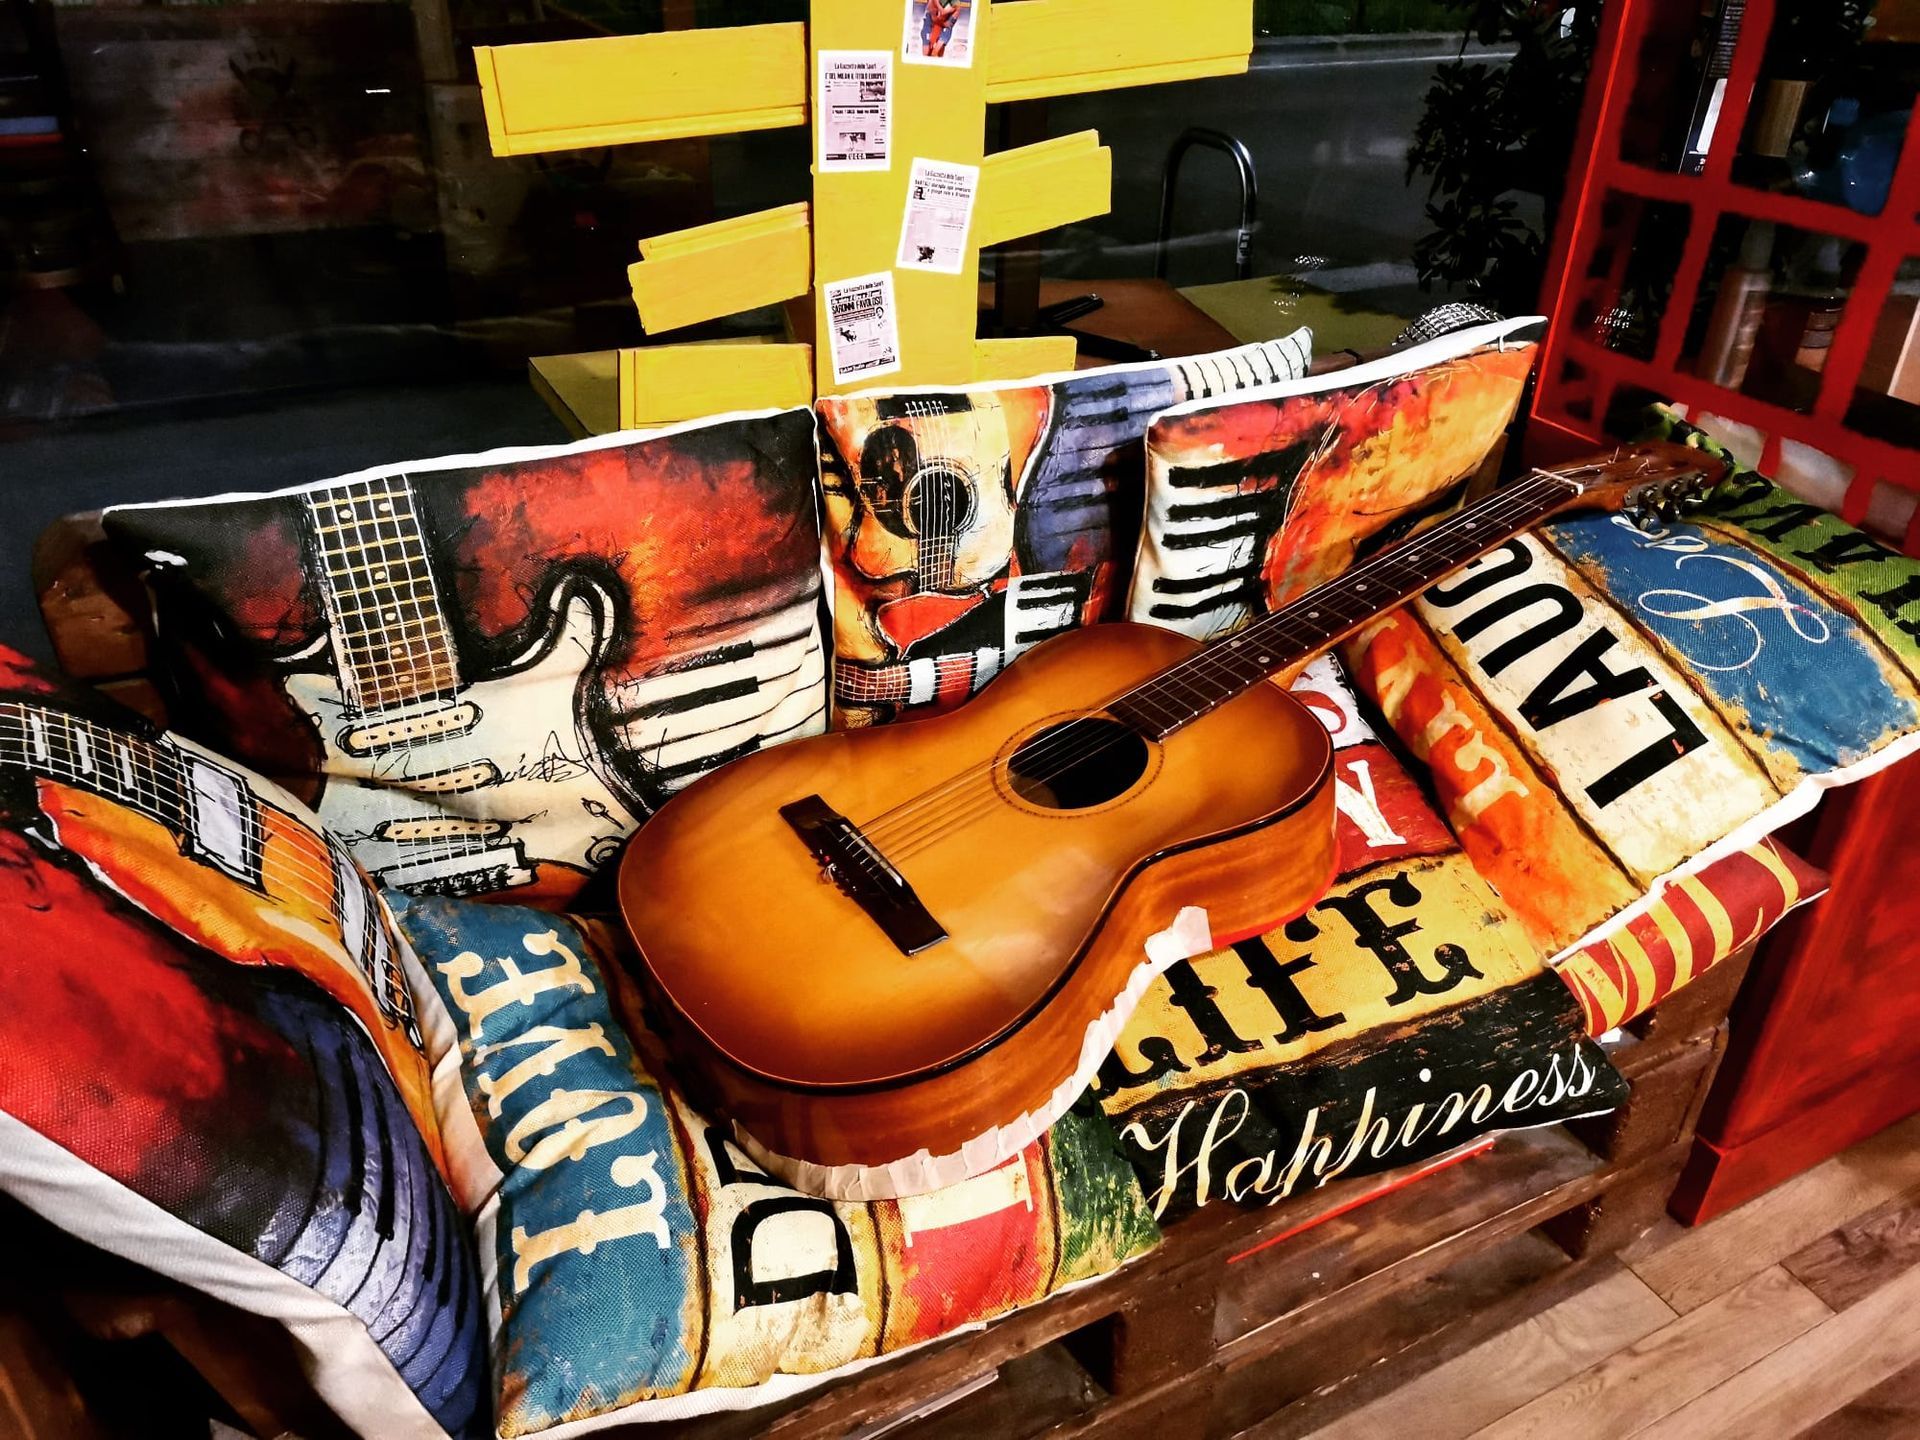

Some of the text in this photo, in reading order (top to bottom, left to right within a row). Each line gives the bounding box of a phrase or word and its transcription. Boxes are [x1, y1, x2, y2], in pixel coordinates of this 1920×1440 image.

[1346, 616, 1530, 833] LIV
[1423, 538, 1710, 810] LAUG
[436, 929, 672, 1294] LOVE
[1118, 1043, 1600, 1221] Happiness
